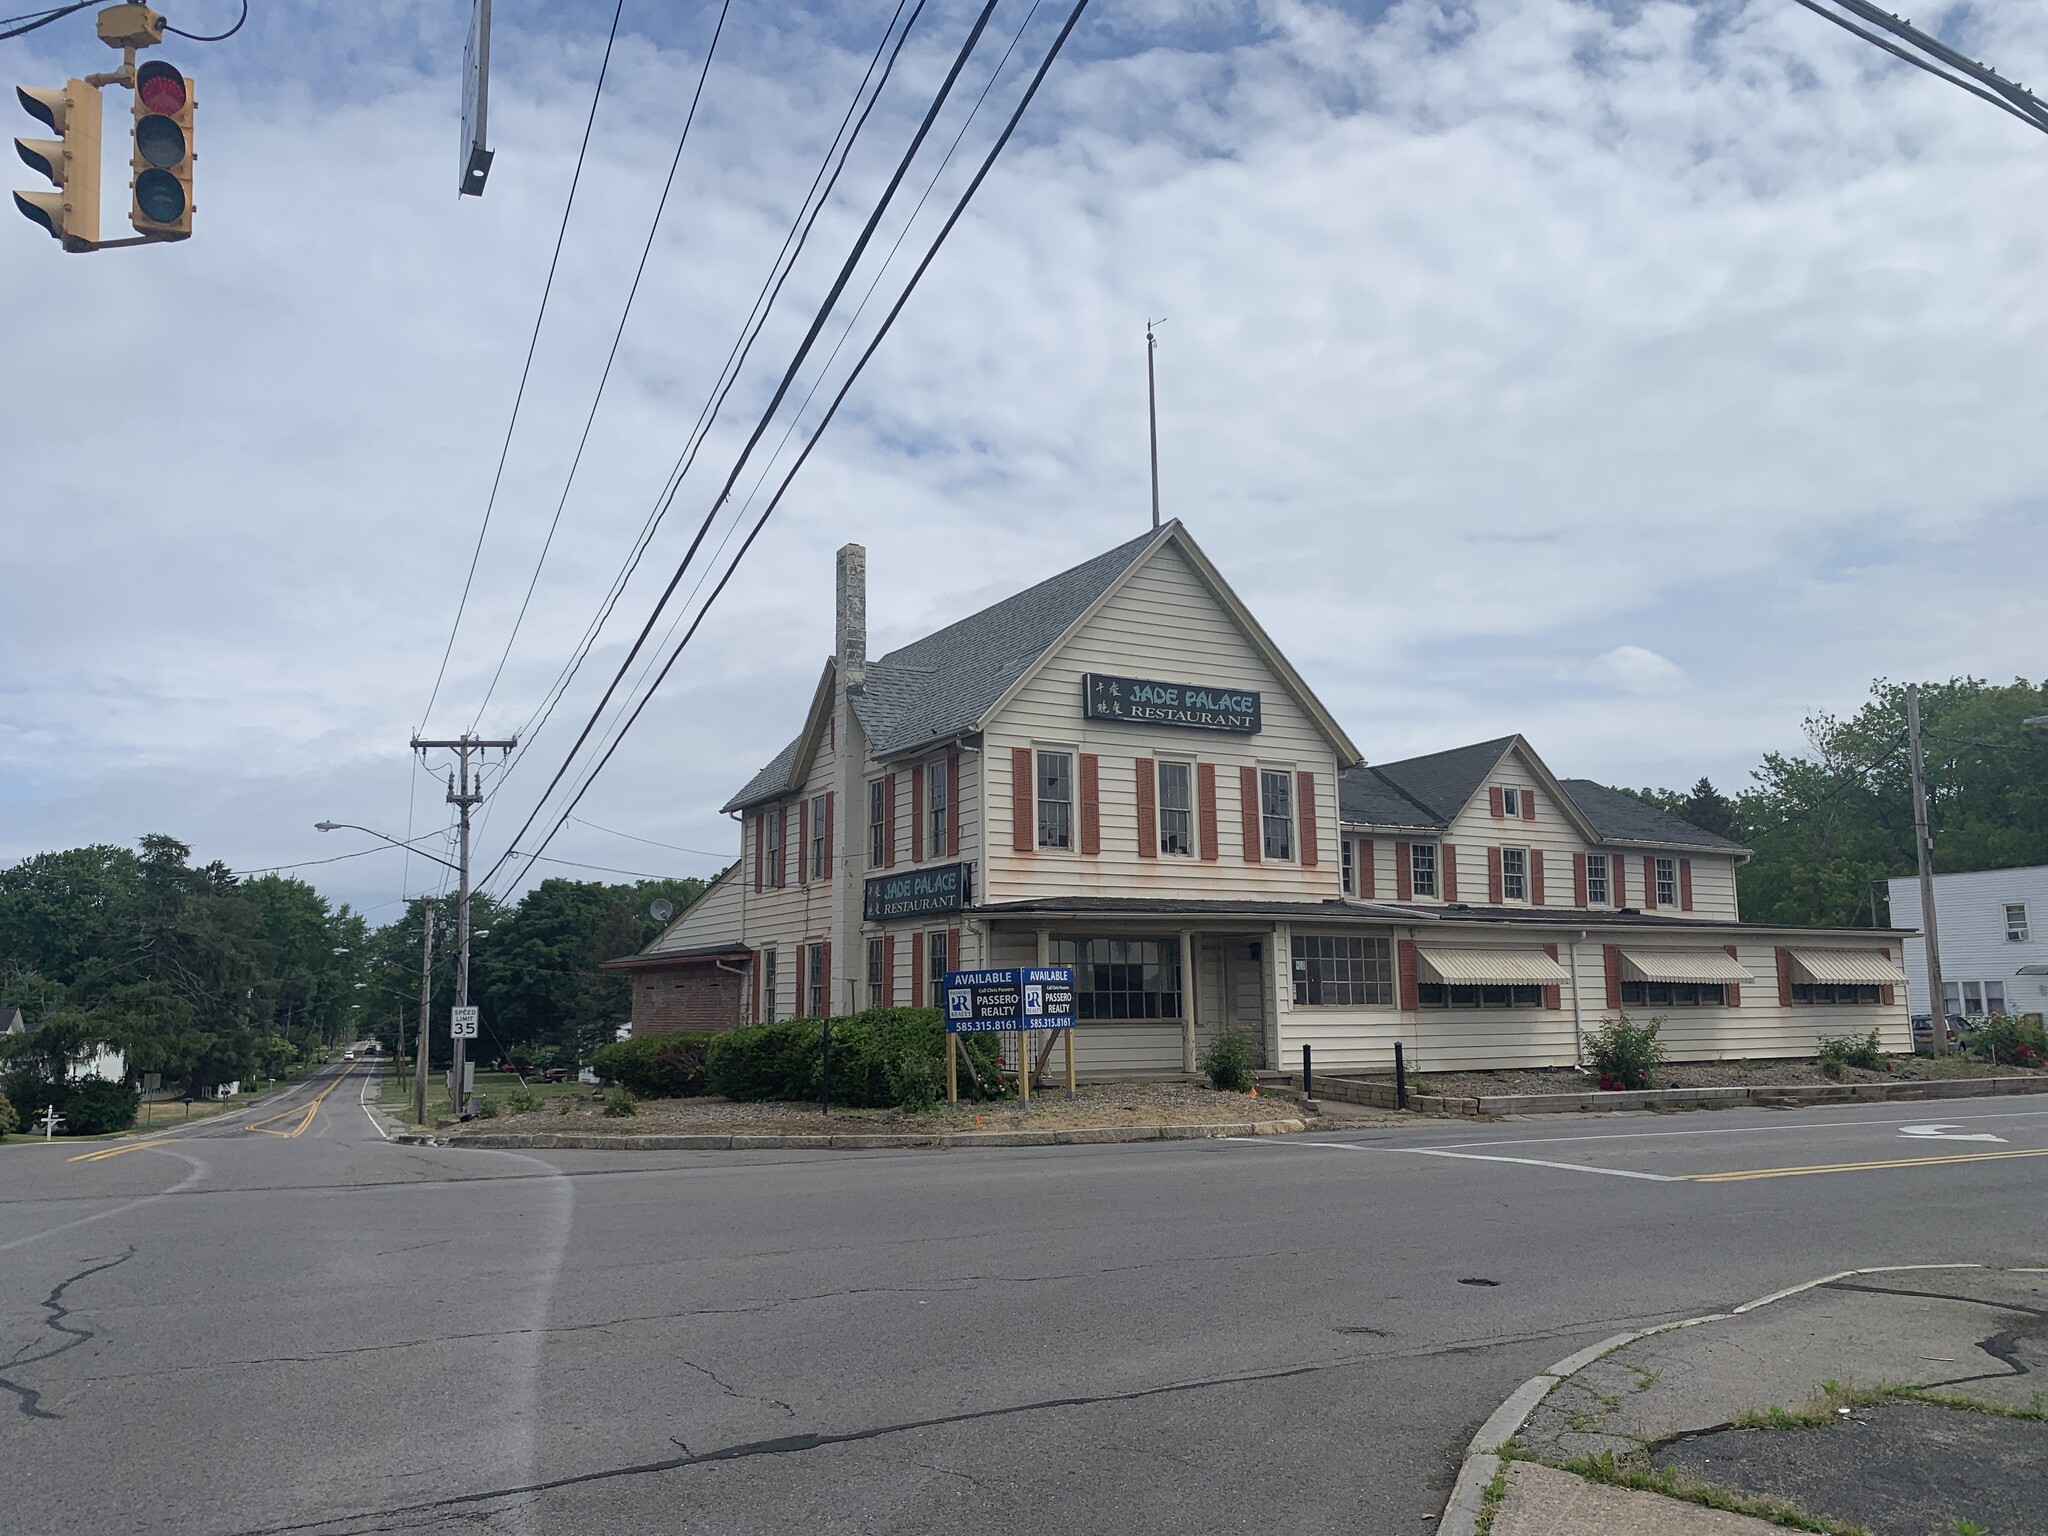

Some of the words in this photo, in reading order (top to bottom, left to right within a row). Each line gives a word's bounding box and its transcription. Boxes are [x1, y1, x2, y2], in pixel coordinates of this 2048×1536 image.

[1129, 684, 1179, 706] JADE
[1185, 689, 1254, 713] PALACE
[1131, 705, 1254, 727] RESTAURANT
[884, 879, 911, 899] JADE
[914, 872, 956, 895] PALACE
[884, 894, 956, 915] RESTAURANT
[954, 972, 1012, 985] AVAILABLE
[1030, 970, 1068, 981] AVAILABLE
[952, 995, 971, 1011] PR
[976, 994, 1019, 1005] PASSERO
[1027, 991, 1041, 1007] PR
[1045, 992, 1072, 1002] PASSERO
[981, 1006, 1015, 1017] REALTY
[1048, 1004, 1070, 1014] REALTY
[454, 1023, 475, 1034] 35
[956, 1020, 1016, 1032] 585.315.8161
[1030, 1017, 1071, 1029] 585.315.8161
